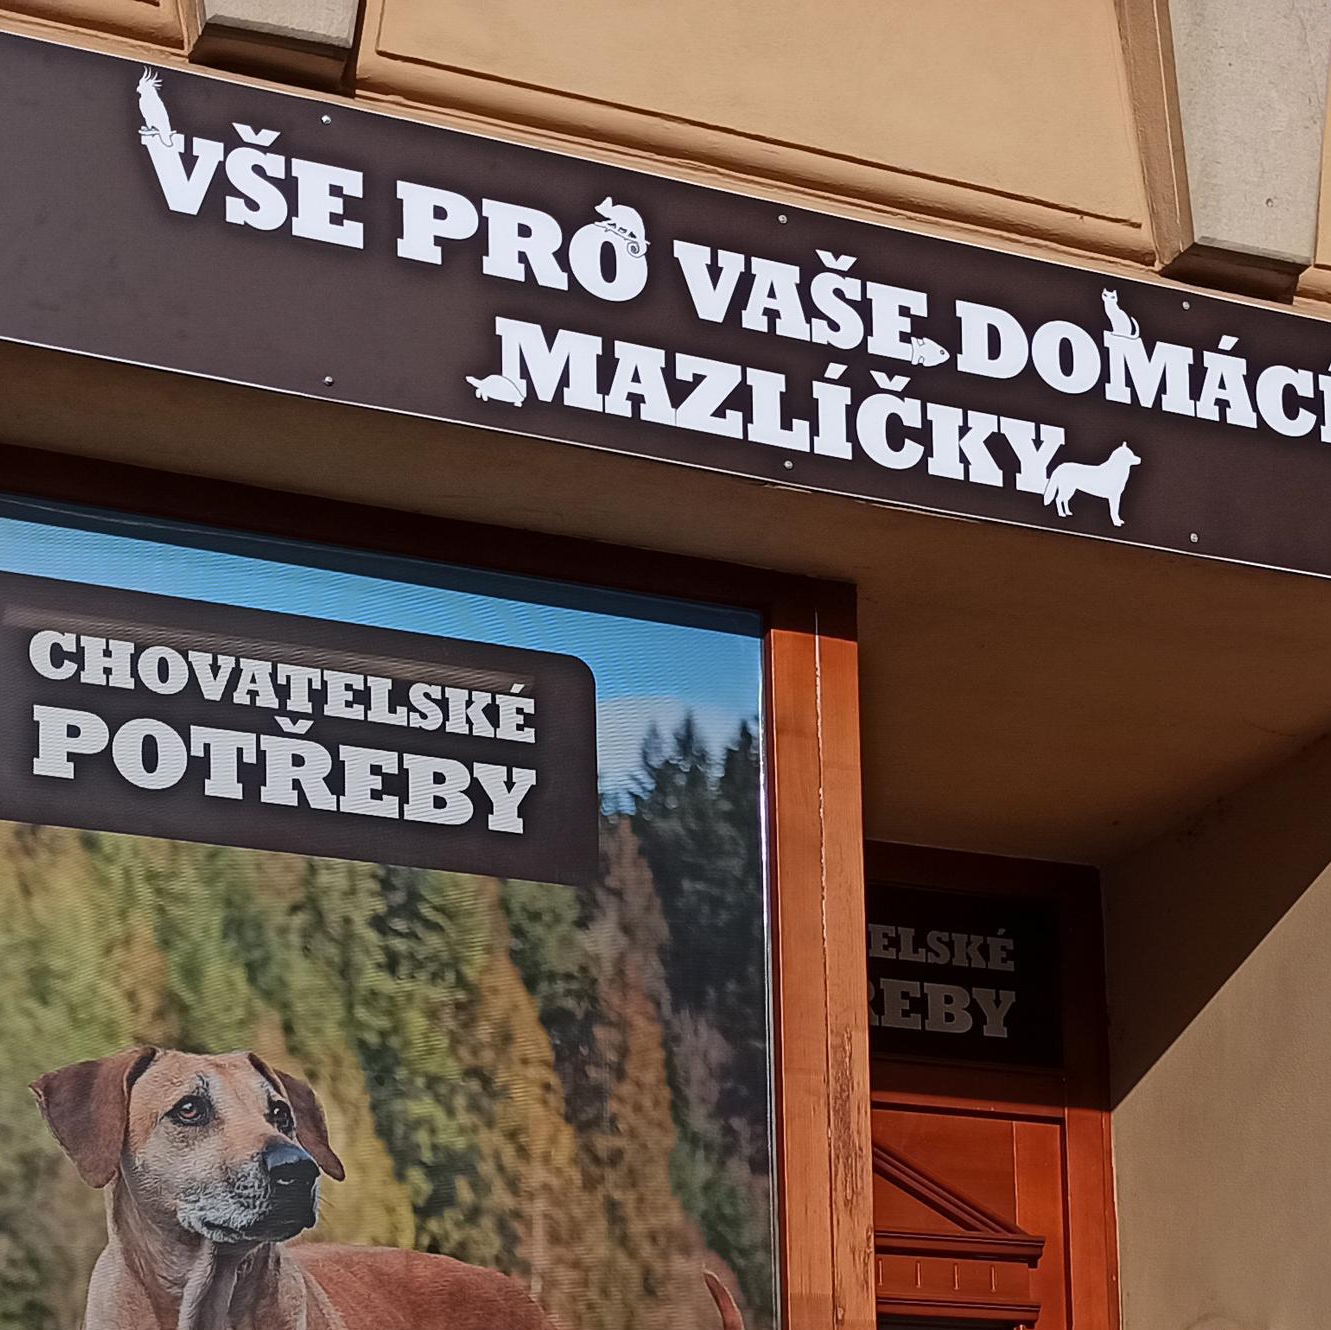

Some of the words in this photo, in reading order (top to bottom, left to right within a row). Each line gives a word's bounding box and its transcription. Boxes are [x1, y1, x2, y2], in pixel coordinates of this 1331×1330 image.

[140, 124, 364, 251] VŠE
[396, 180, 649, 303] PRO
[673, 239, 929, 361] VAŠE
[496, 316, 1067, 496] MAZLÍČKY
[28, 630, 536, 744] CHOVATELSKÉ
[32, 704, 537, 834] POTŘEBY
